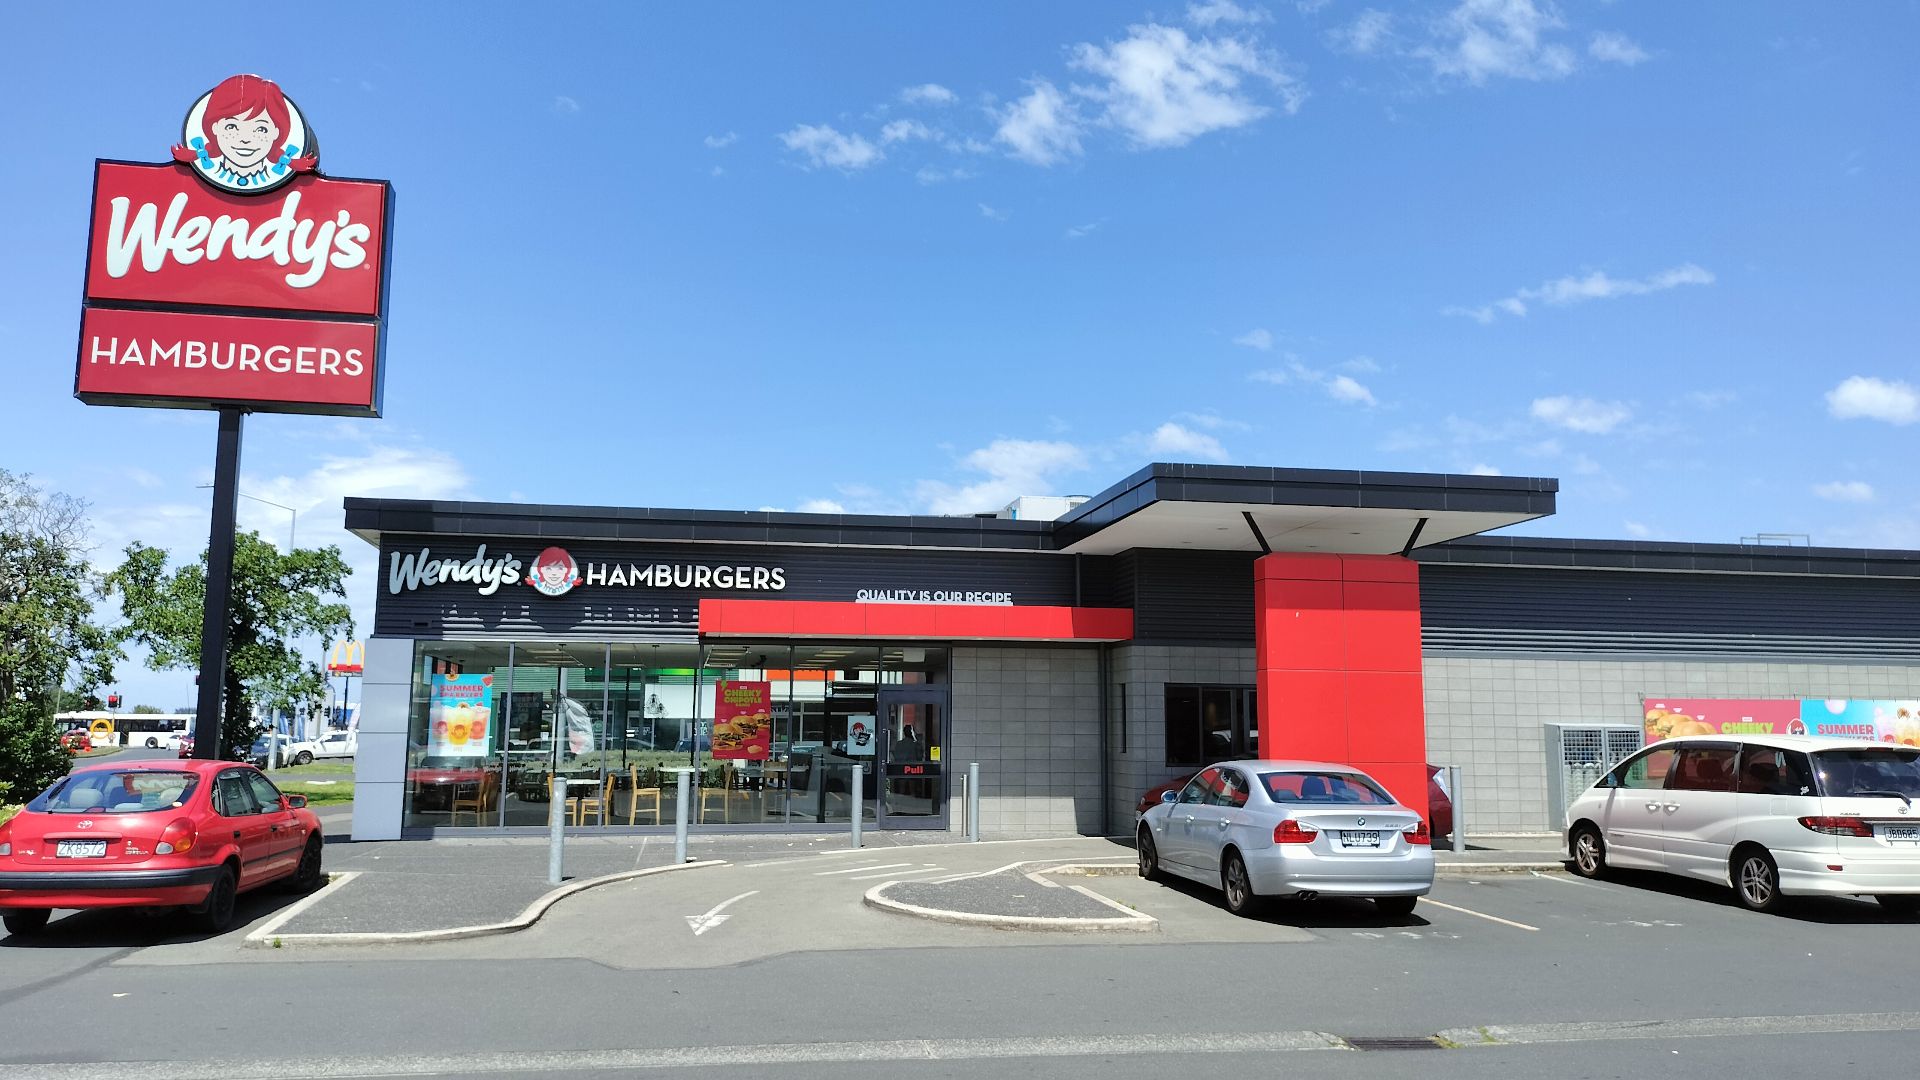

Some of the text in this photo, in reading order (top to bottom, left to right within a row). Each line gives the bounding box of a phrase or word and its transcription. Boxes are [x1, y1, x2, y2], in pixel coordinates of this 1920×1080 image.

[106, 190, 371, 288] Wendy's
[91, 336, 365, 377] HAMBURGERS
[389, 544, 521, 596] Wendy's
[587, 563, 786, 592] HAMBURGERS
[856, 589, 1012, 604] QUALITY IS OUR RECIPE
[1721, 722, 1774, 734] CHEEKY
[1817, 724, 1874, 735] SUMMER
[904, 766, 923, 774] Pull
[1342, 832, 1378, 843] NLU739
